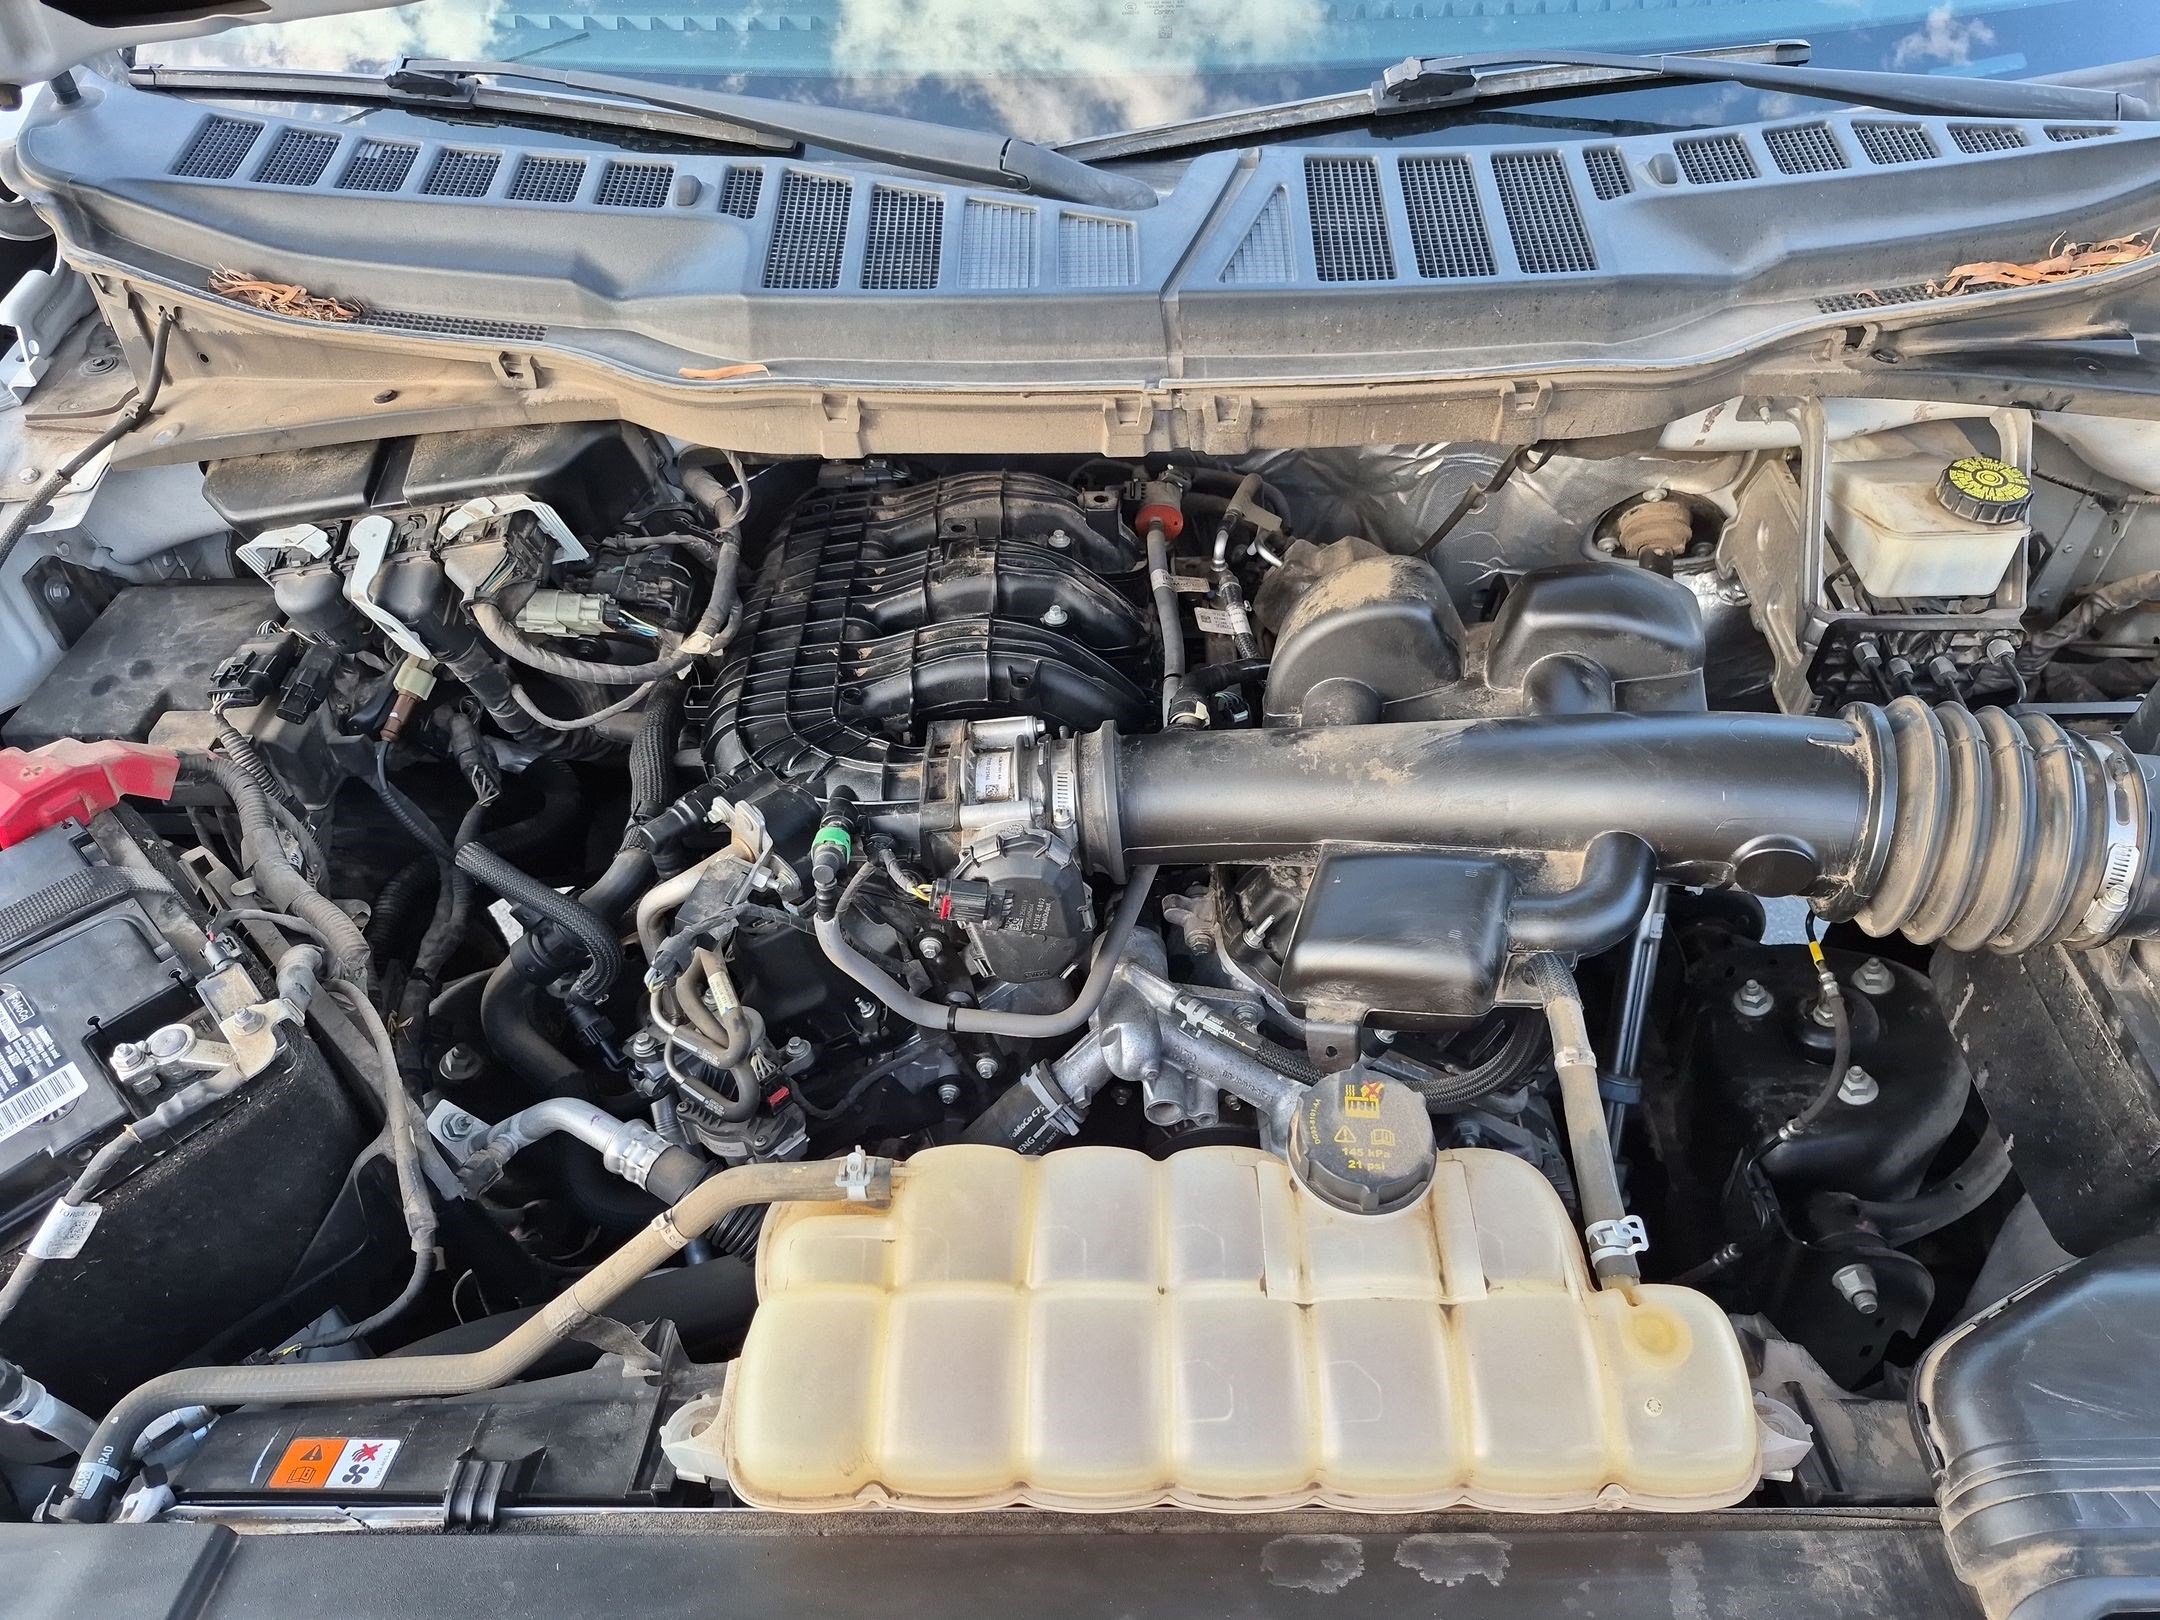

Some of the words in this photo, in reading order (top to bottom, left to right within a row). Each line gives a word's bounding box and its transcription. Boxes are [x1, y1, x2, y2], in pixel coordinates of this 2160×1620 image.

[9, 993, 30, 1020] FoMoCo
[1017, 1136, 1036, 1153] ENG
[1341, 1147, 1364, 1157] 145
[1367, 1148, 1392, 1159] kPa
[1348, 1159, 1363, 1169] 21
[1367, 1162, 1385, 1172] psi
[98, 1445, 114, 1465] RAD
